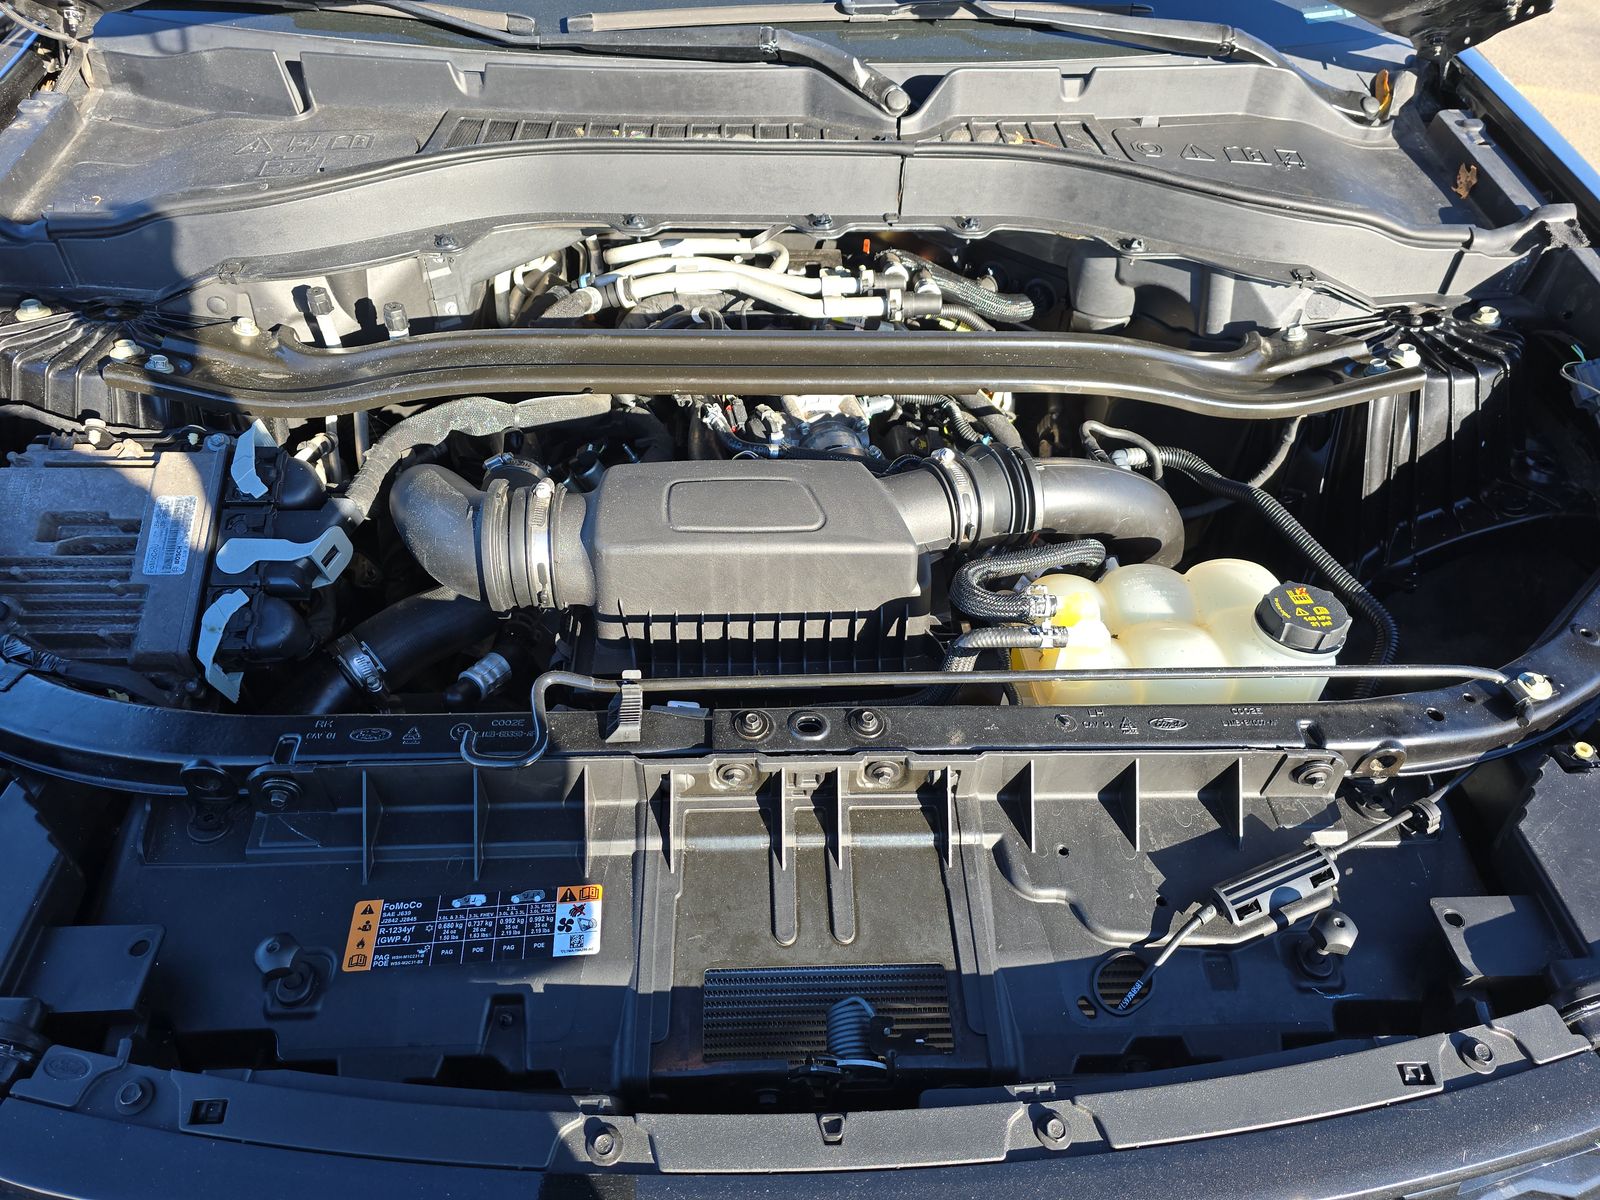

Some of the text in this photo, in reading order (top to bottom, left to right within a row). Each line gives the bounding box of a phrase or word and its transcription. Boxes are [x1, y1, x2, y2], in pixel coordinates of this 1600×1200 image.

[174, 545, 183, 565] BOSCH
[383, 901, 423, 911] FoMoCo
[484, 919, 493, 927] kg
[516, 917, 525, 925] kg
[546, 915, 554, 923] kg
[379, 925, 416, 935] R-1234yf
[437, 921, 464, 930] 0.680 kg
[377, 935, 411, 945] (GWP 4)
[374, 953, 390, 961] PAG
